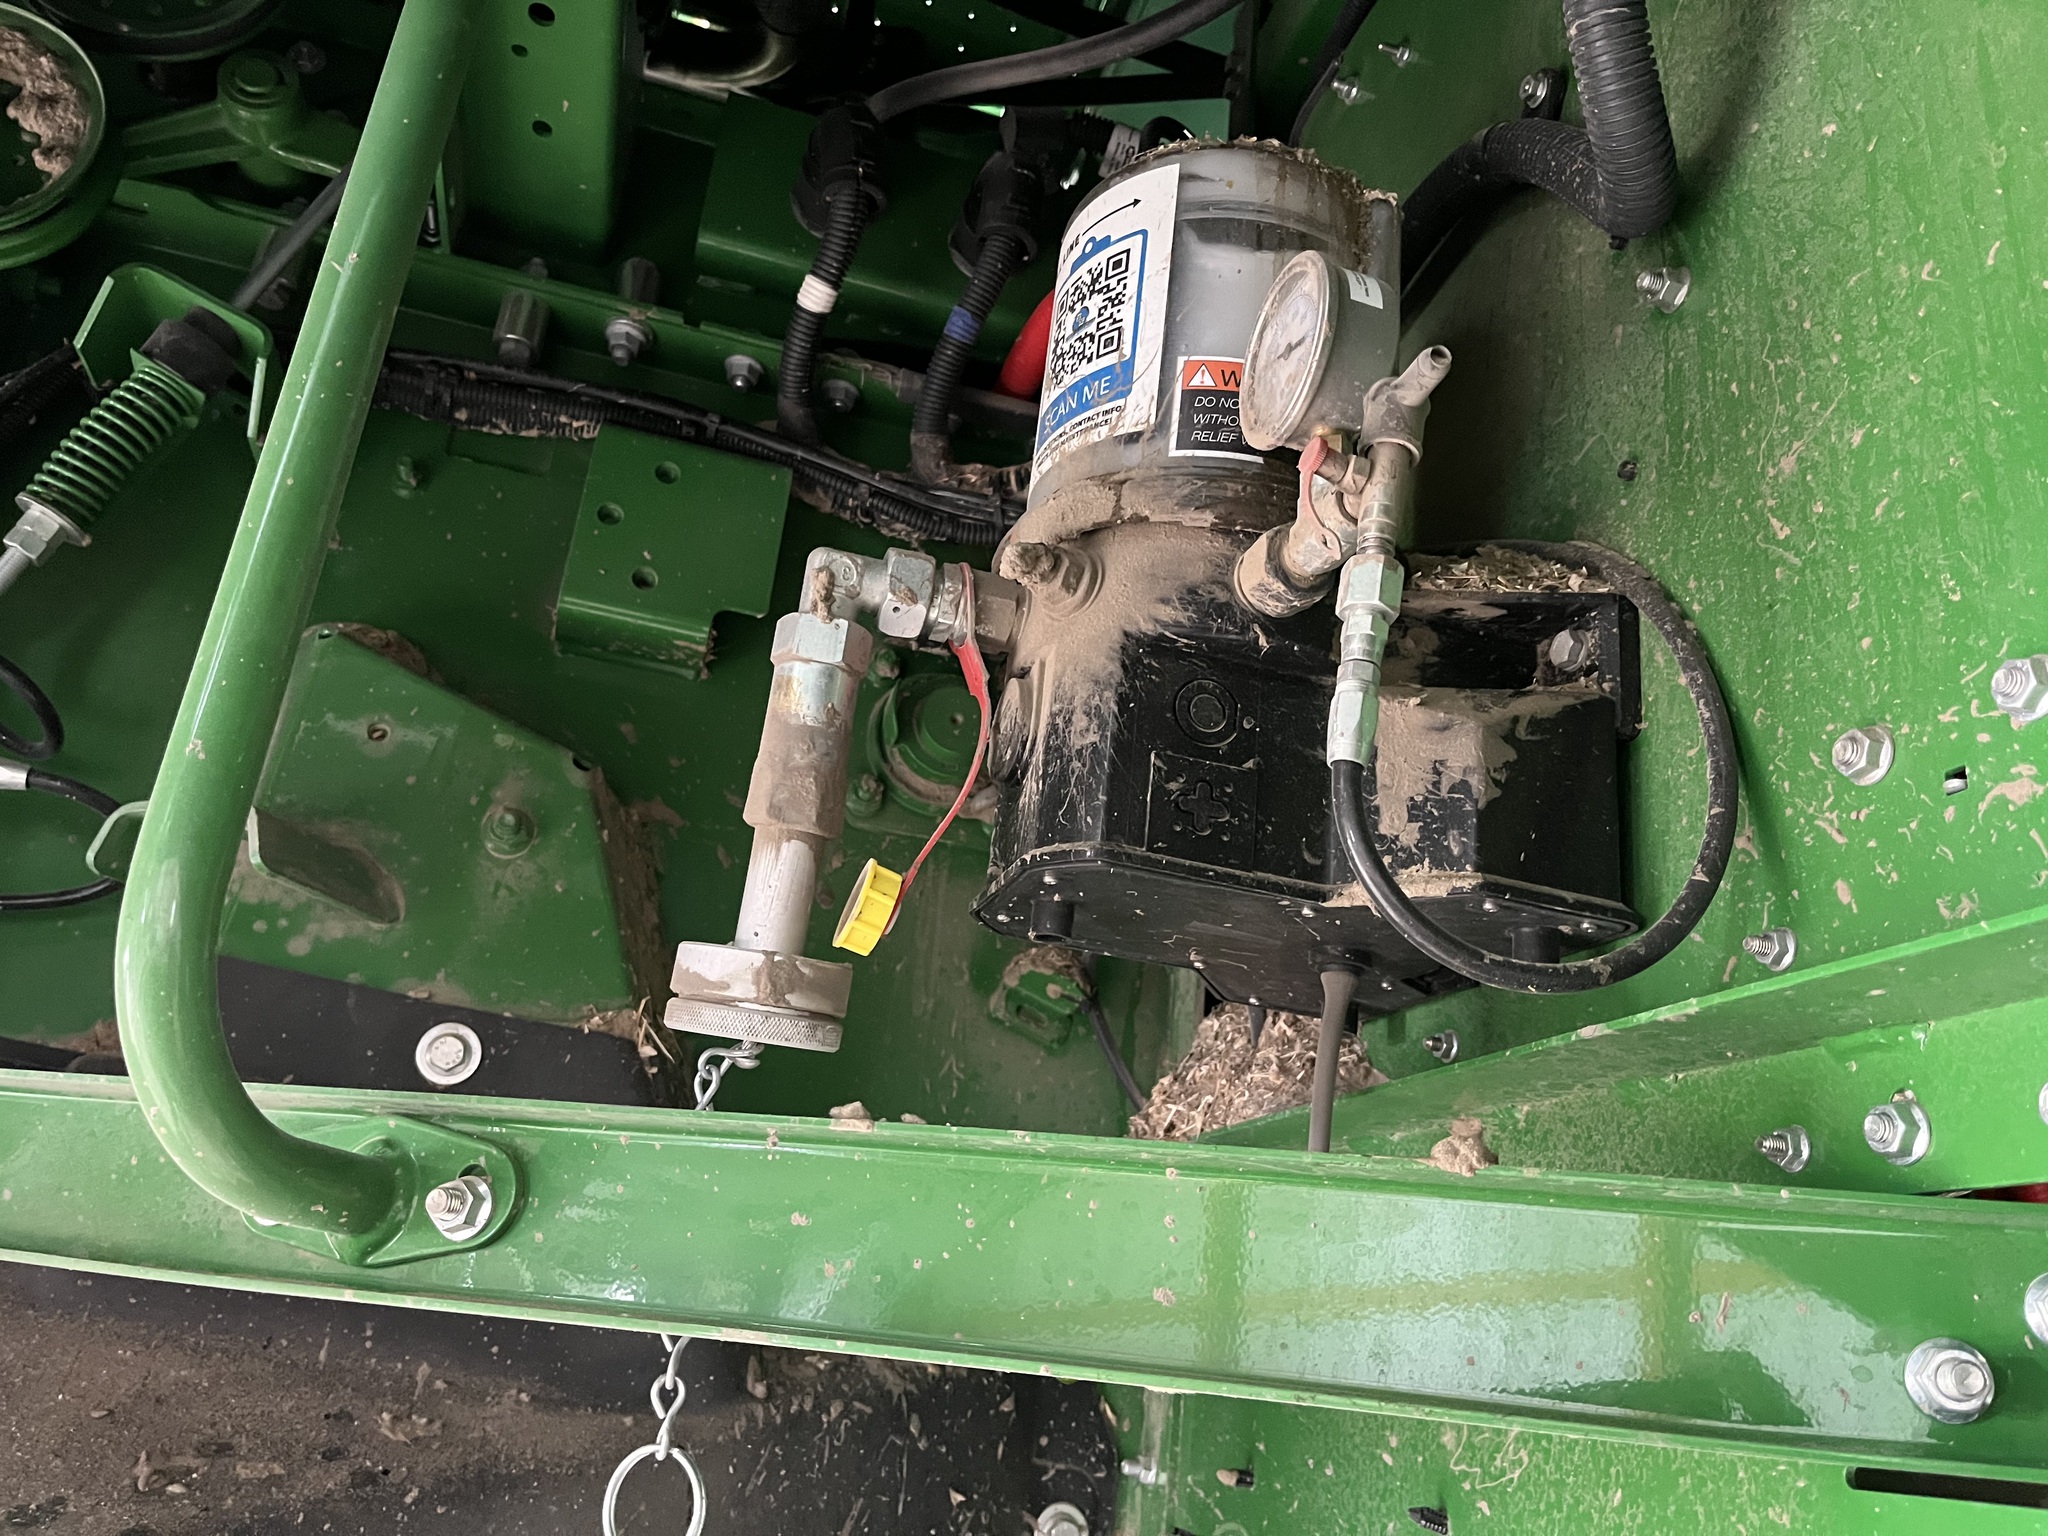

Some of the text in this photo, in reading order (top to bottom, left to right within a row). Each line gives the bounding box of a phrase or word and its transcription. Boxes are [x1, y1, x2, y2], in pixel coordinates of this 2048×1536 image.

[1044, 375, 1112, 435] SCAN ME
[1194, 396, 1216, 408] DO
[1069, 405, 1122, 432] CONTACT INFO
[1190, 430, 1239, 443] RELIEF
